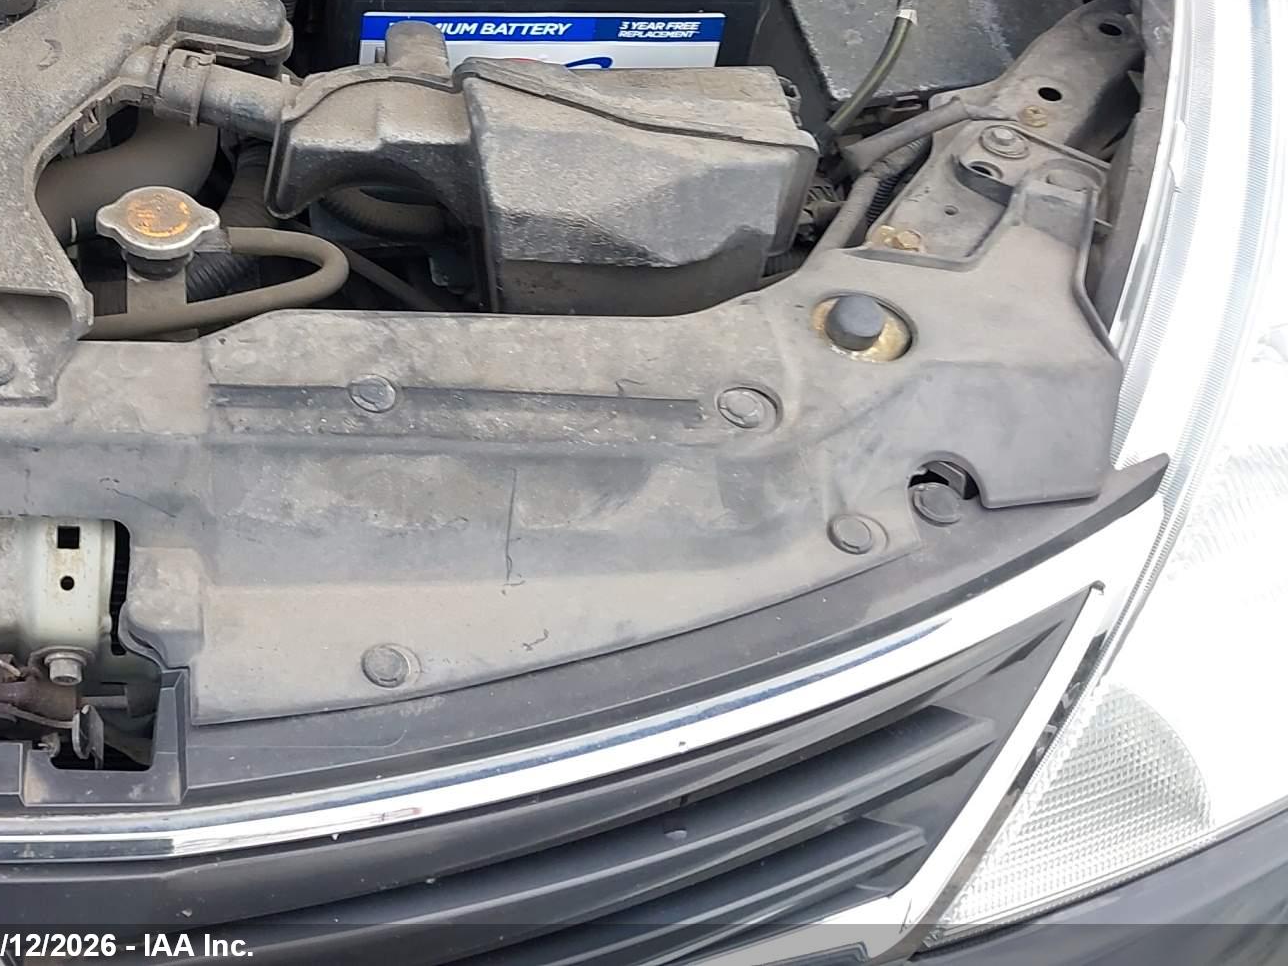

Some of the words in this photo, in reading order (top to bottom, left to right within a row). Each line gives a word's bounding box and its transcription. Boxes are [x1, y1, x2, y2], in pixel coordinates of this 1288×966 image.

[480, 22, 572, 36] BATTERY
[619, 21, 630, 30] 3
[631, 21, 666, 30] YEAR
[665, 21, 702, 30] FREE
[617, 30, 700, 38] REPLACEMENT
